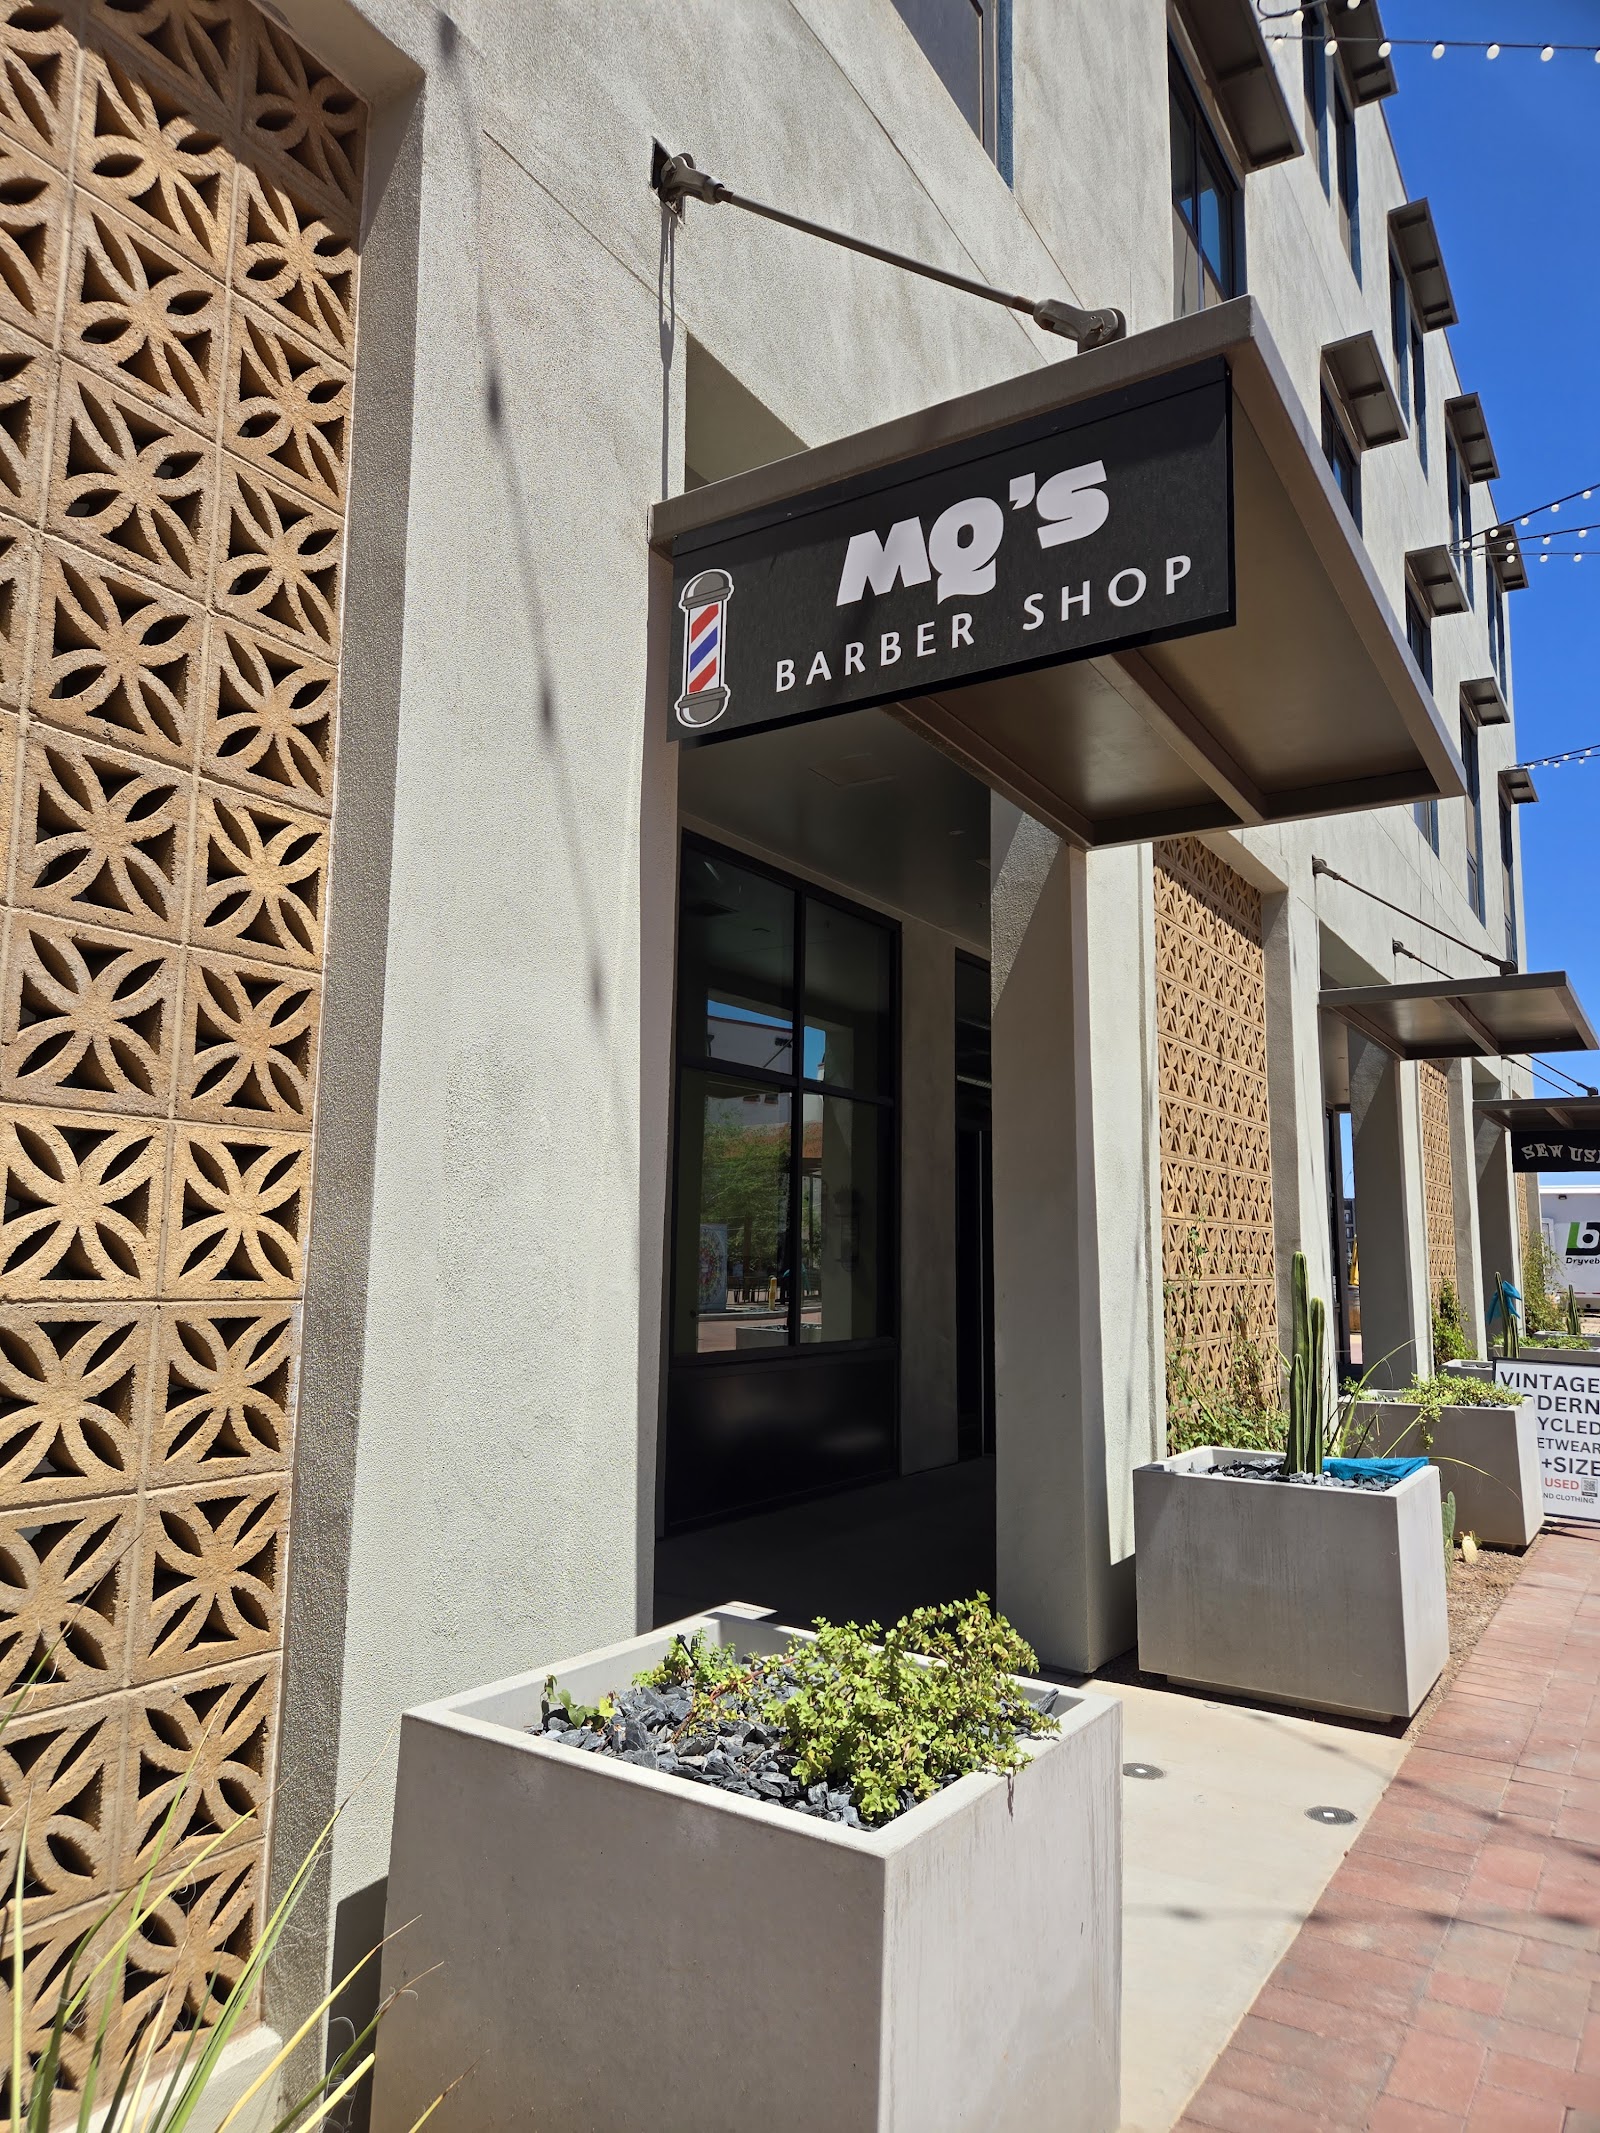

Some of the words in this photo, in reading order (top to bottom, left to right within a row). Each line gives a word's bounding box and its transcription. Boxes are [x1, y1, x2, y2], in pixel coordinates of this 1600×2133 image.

[836, 460, 1110, 605] MQ'S
[775, 612, 975, 693] BARBER
[1022, 555, 1193, 631] SHOP
[1521, 1143, 1563, 1160] SEW
[1500, 1371, 1600, 1394] VINTAGE
[1522, 1394, 1600, 1415] DERN
[1545, 1477, 1580, 1490] USED
[1556, 1495, 1595, 1504] CLOTHING
